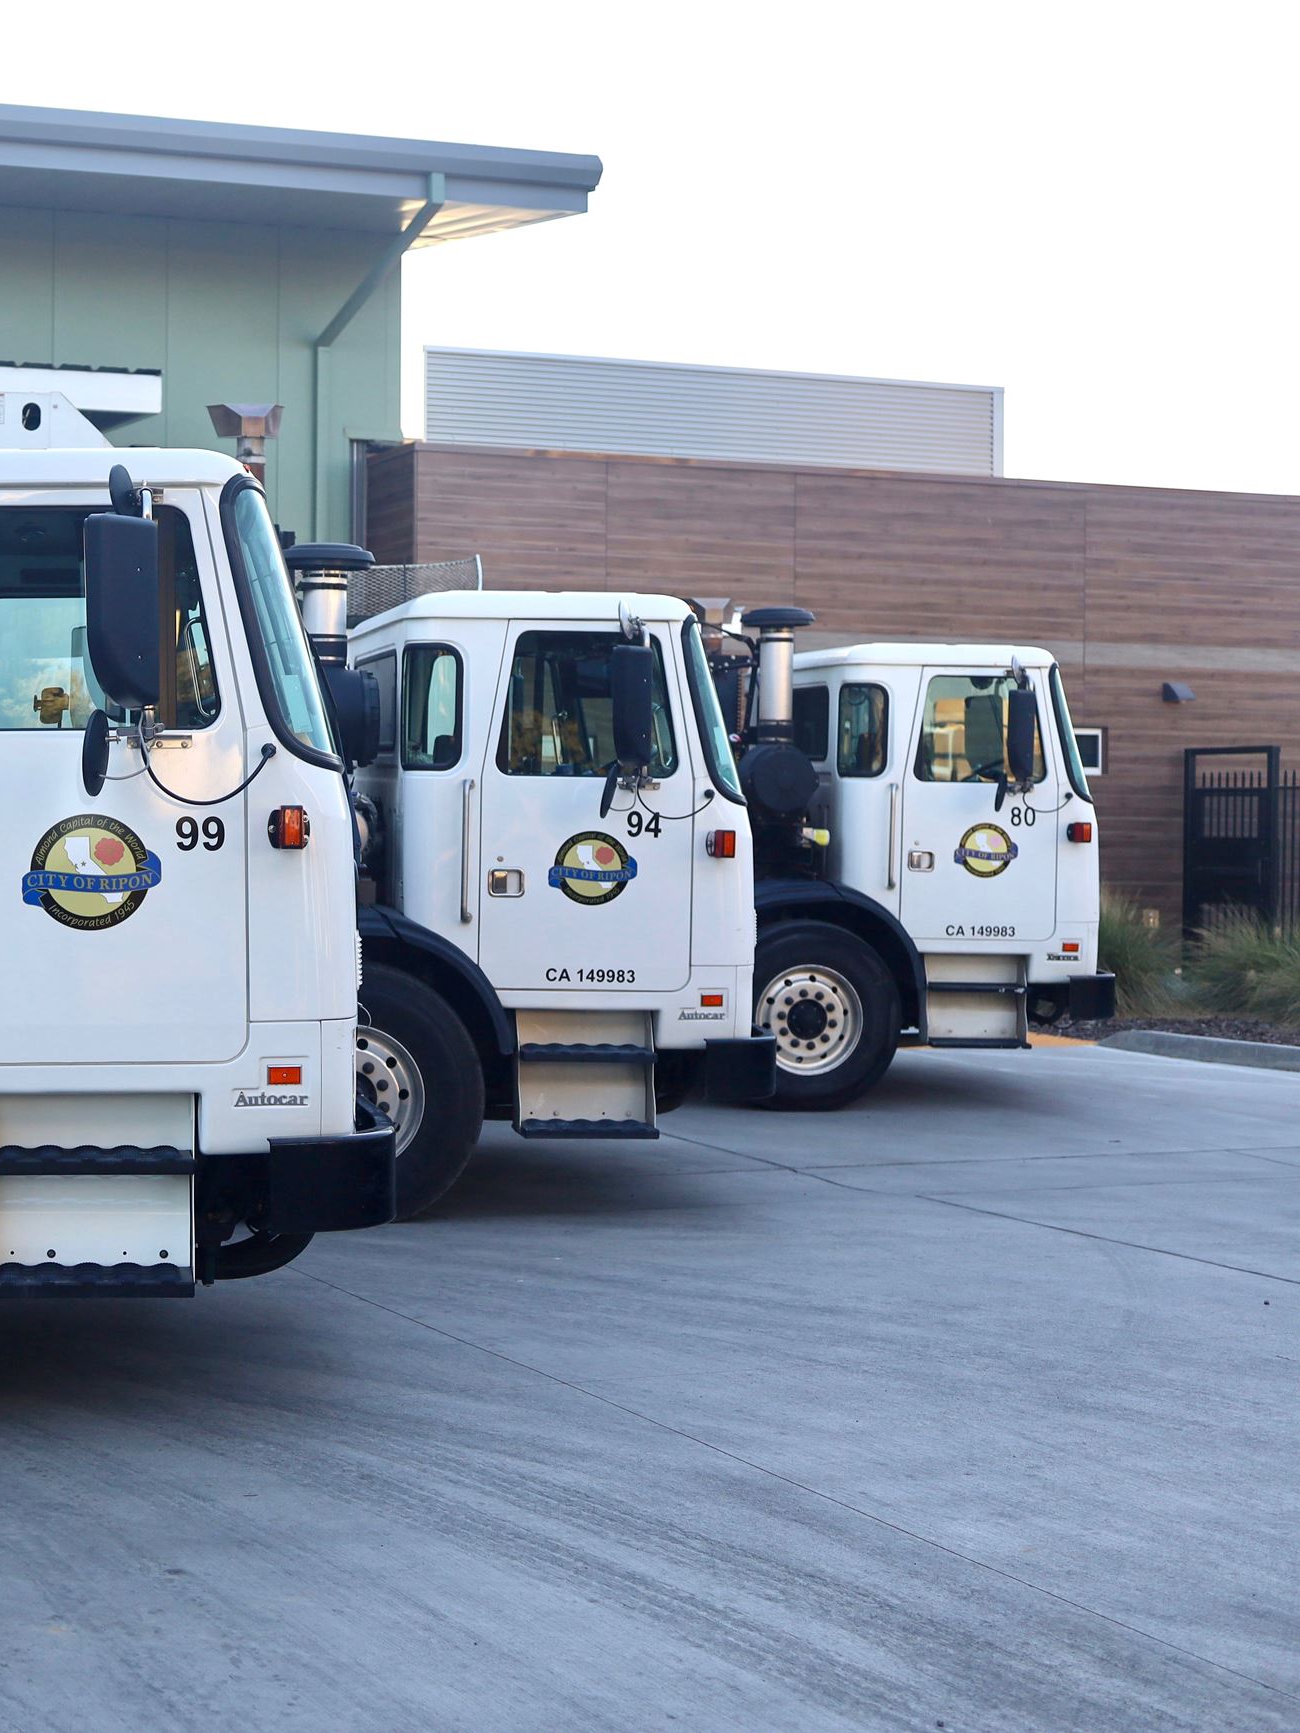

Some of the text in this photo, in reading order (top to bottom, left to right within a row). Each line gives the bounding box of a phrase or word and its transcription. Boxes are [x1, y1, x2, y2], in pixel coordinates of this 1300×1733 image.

[627, 811, 662, 838] 94
[1010, 807, 1035, 826] 80
[35, 817, 146, 866] Almond Capital of the World
[176, 817, 225, 851] 99
[27, 873, 153, 890] CITY OF RIPON
[551, 868, 631, 880] CITY OF RIPON
[49, 900, 135, 927] Incorporated 1945
[946, 926, 1015, 937] CA 149983
[545, 968, 635, 983] CA 149983
[678, 1010, 725, 1021] Autocar
[234, 1091, 308, 1108] Autocar
